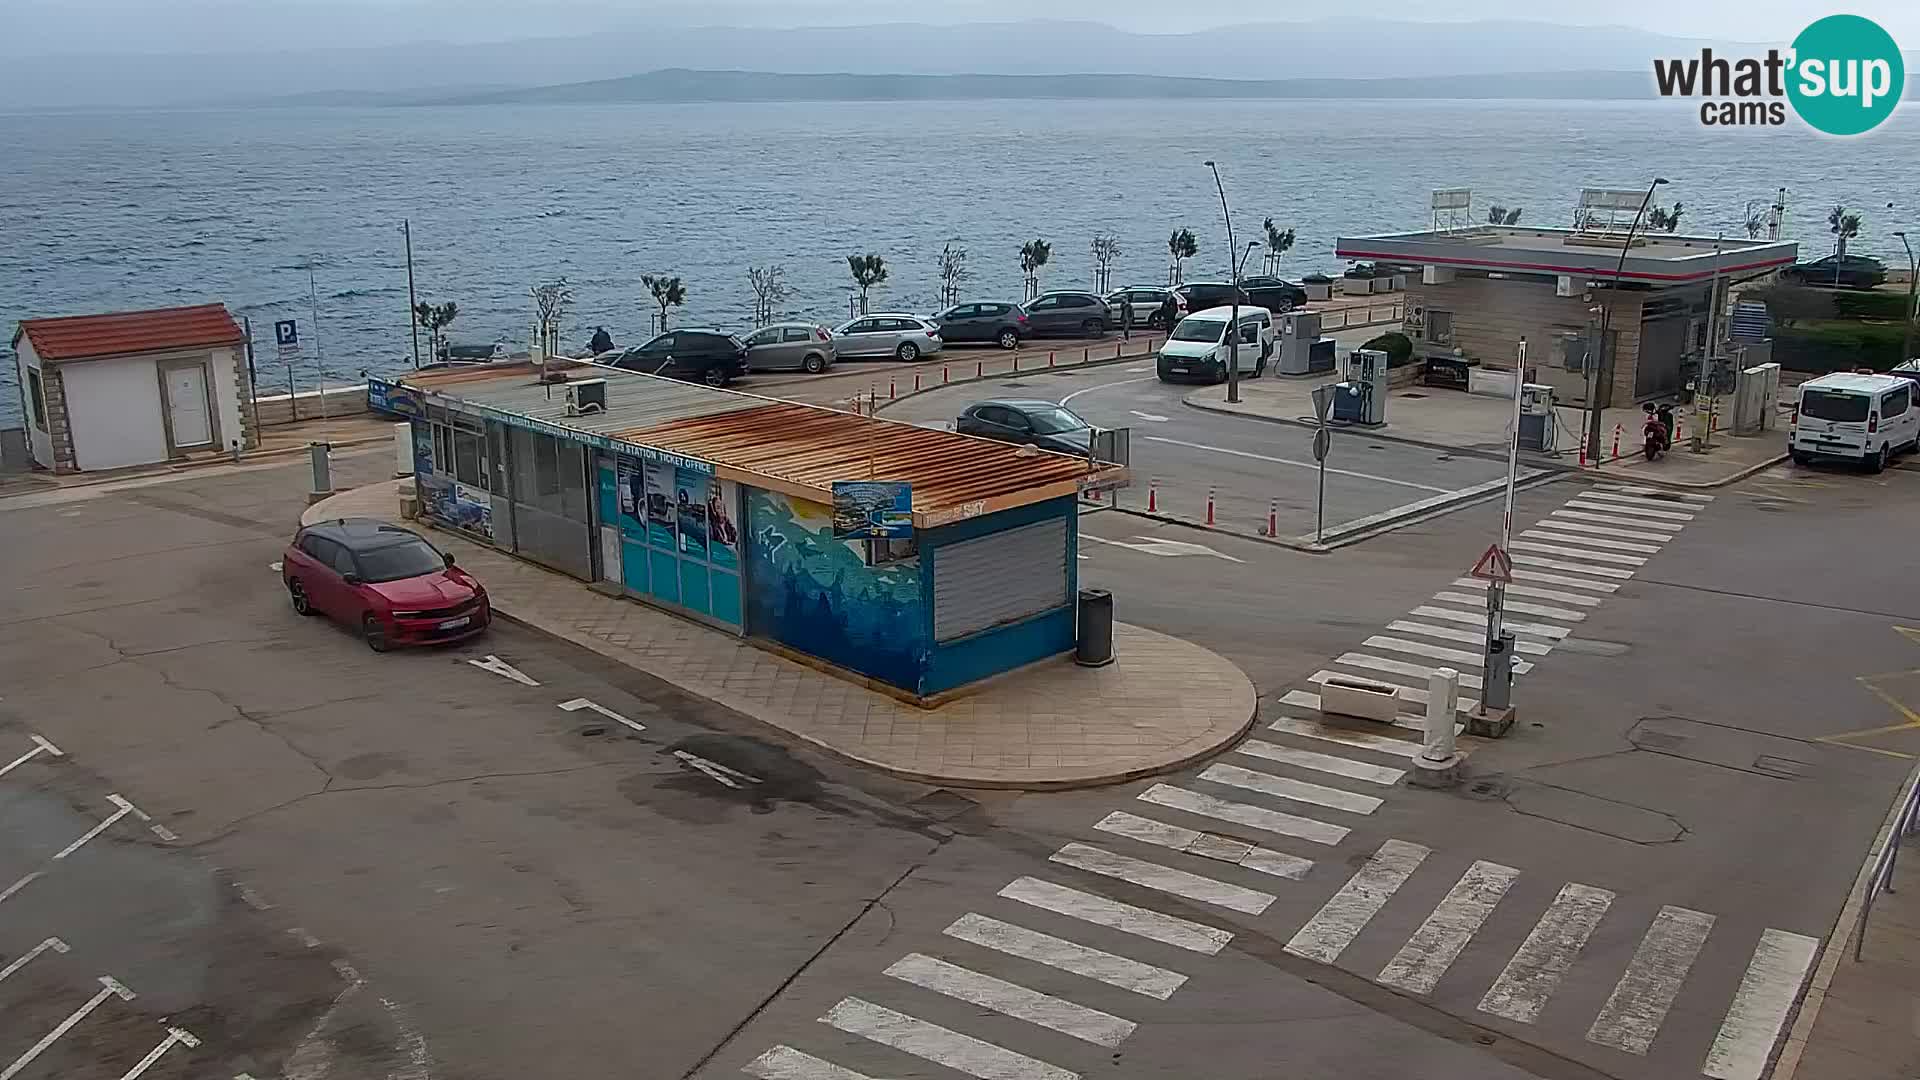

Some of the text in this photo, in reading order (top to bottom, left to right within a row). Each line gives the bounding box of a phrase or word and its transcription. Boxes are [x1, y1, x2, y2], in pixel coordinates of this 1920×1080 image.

[280, 324, 291, 341] P
[610, 441, 624, 452] BUS
[625, 445, 656, 460] STATION
[659, 454, 684, 468] TICKET
[685, 459, 711, 473] OFFICE
